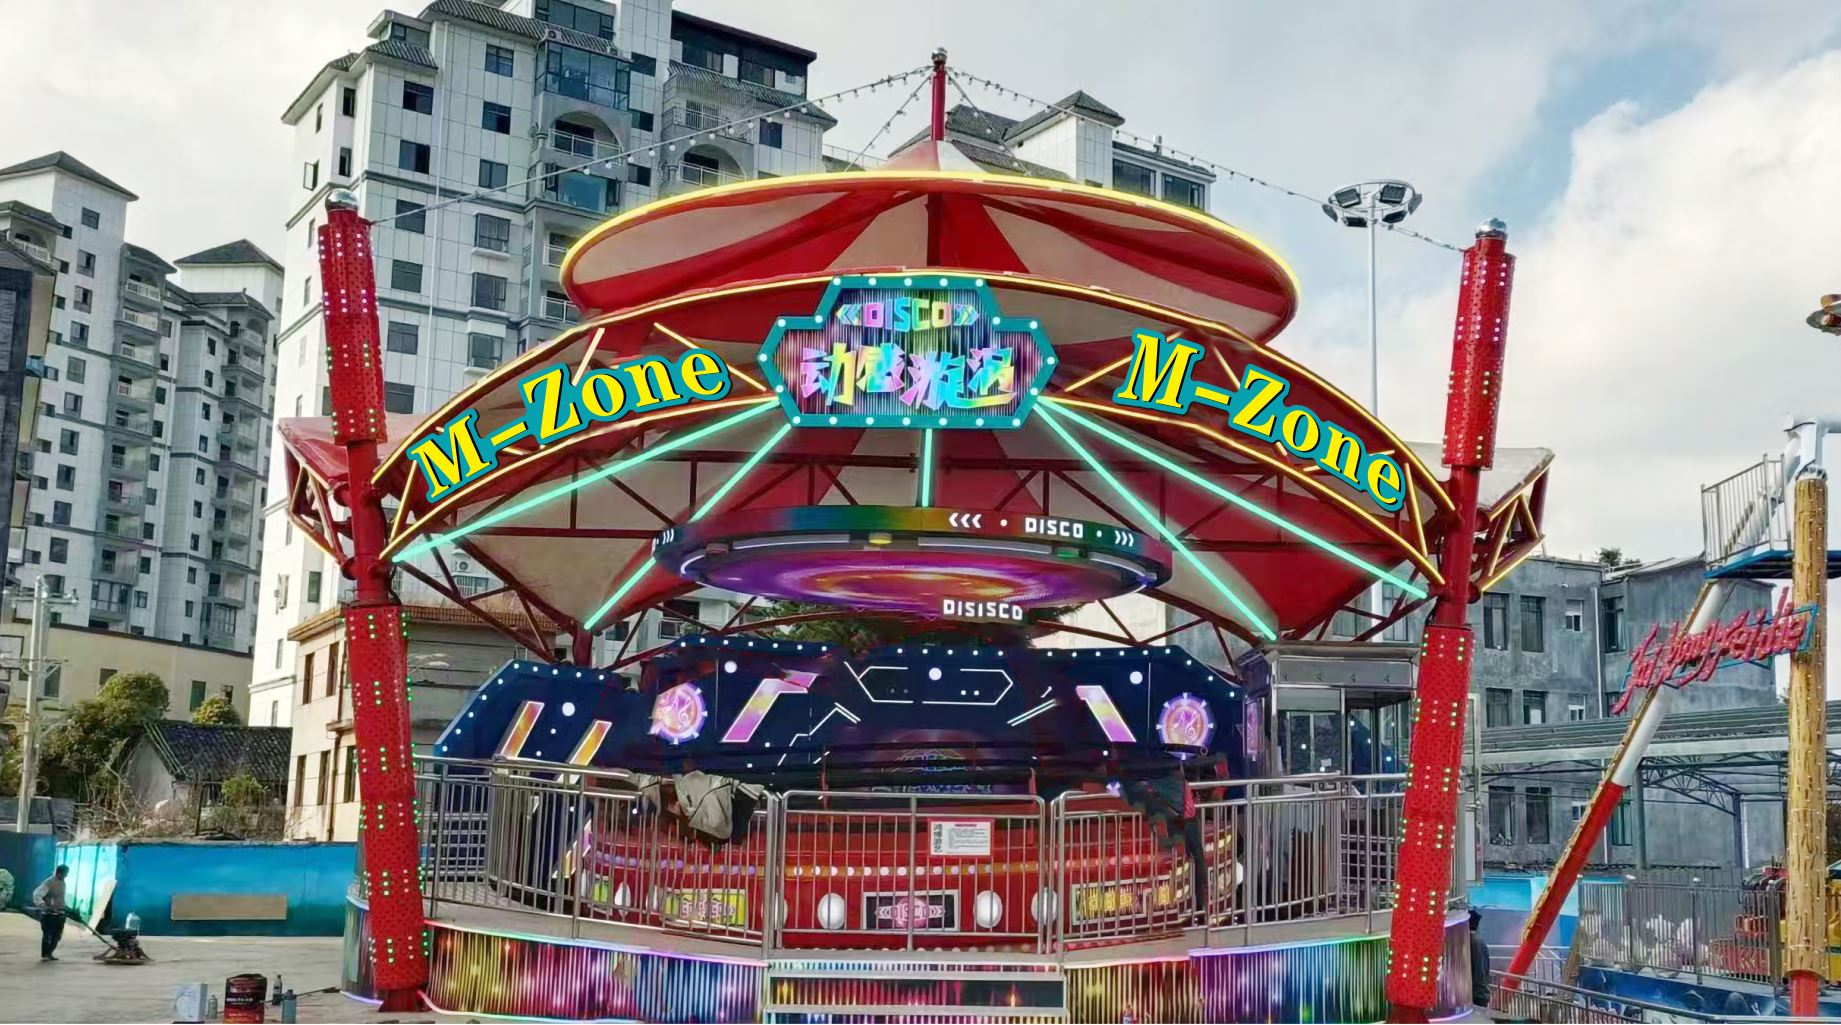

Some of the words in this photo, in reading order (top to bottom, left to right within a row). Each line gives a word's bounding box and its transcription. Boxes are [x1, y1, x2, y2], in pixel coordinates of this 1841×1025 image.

[865, 297, 951, 332] DISCO
[411, 353, 726, 498] M-Zone
[1117, 333, 1402, 505] M-Zone
[1025, 517, 1084, 539] DISCO
[943, 599, 1023, 621] DISISCO
